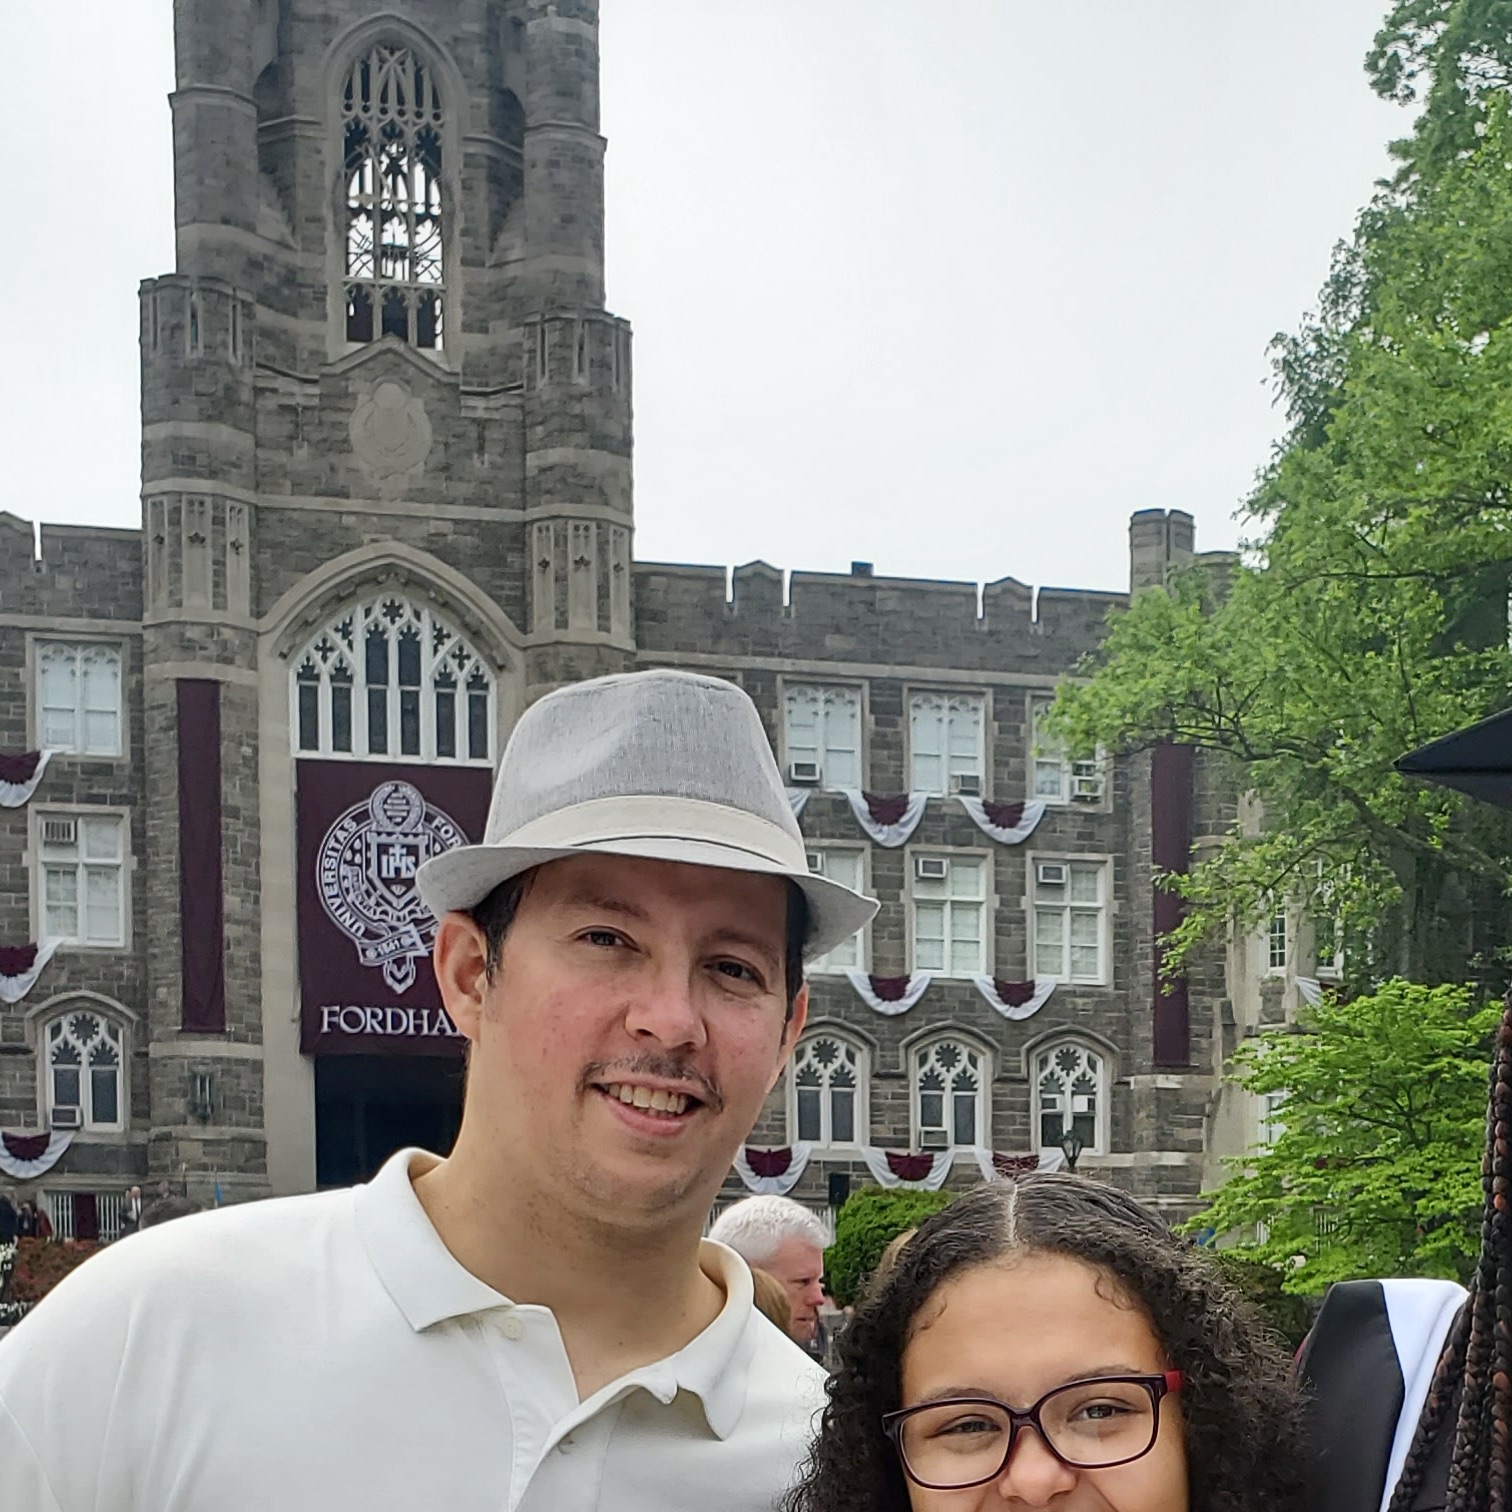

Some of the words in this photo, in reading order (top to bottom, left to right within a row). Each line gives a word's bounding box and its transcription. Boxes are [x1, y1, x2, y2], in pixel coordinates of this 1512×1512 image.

[323, 818, 366, 937] UNIVERSITAS
[432, 815, 461, 848] FOR
[381, 845, 416, 879] IHS
[320, 1004, 461, 1037] FORDHA
